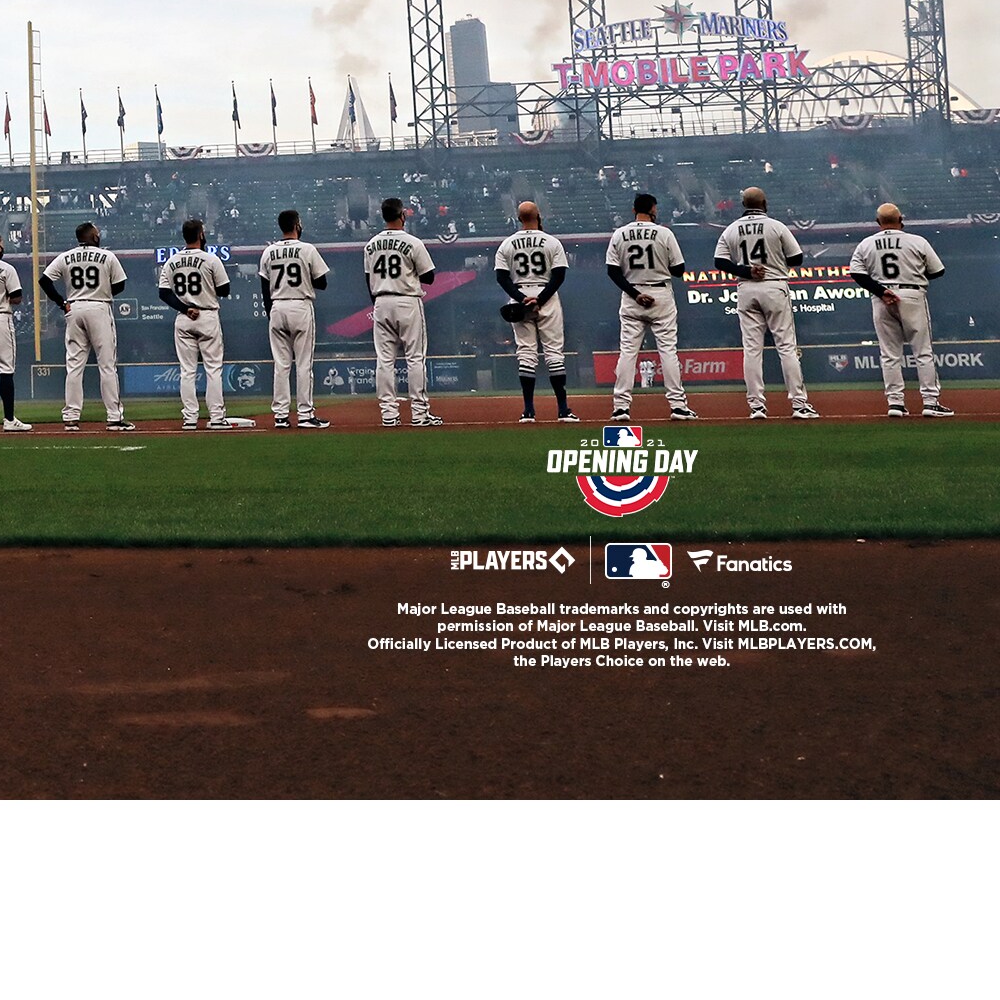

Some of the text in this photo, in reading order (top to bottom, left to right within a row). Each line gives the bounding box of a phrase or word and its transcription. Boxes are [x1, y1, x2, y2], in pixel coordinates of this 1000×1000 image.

[573, 11, 790, 52] SEATTLE MARINERS
[551, 50, 813, 90] T-MOBILE PARK
[621, 228, 658, 242] LAKER
[738, 223, 764, 237] ACTA
[270, 247, 301, 261] BLANK
[366, 238, 413, 256] SANDBERG
[511, 237, 547, 250] VITALE
[739, 238, 768, 266] 14
[875, 237, 903, 250] HILL
[64, 251, 107, 265] CABRERA
[373, 254, 402, 279] 48
[513, 251, 546, 276] 39
[627, 243, 655, 270] 21
[880, 253, 900, 280] 6
[70, 265, 100, 290] 89
[172, 272, 202, 296] 88
[271, 262, 302, 290] 79
[687, 290, 713, 304] Dr.
[800, 303, 835, 313] Hospital
[37, 367, 51, 377] 331
